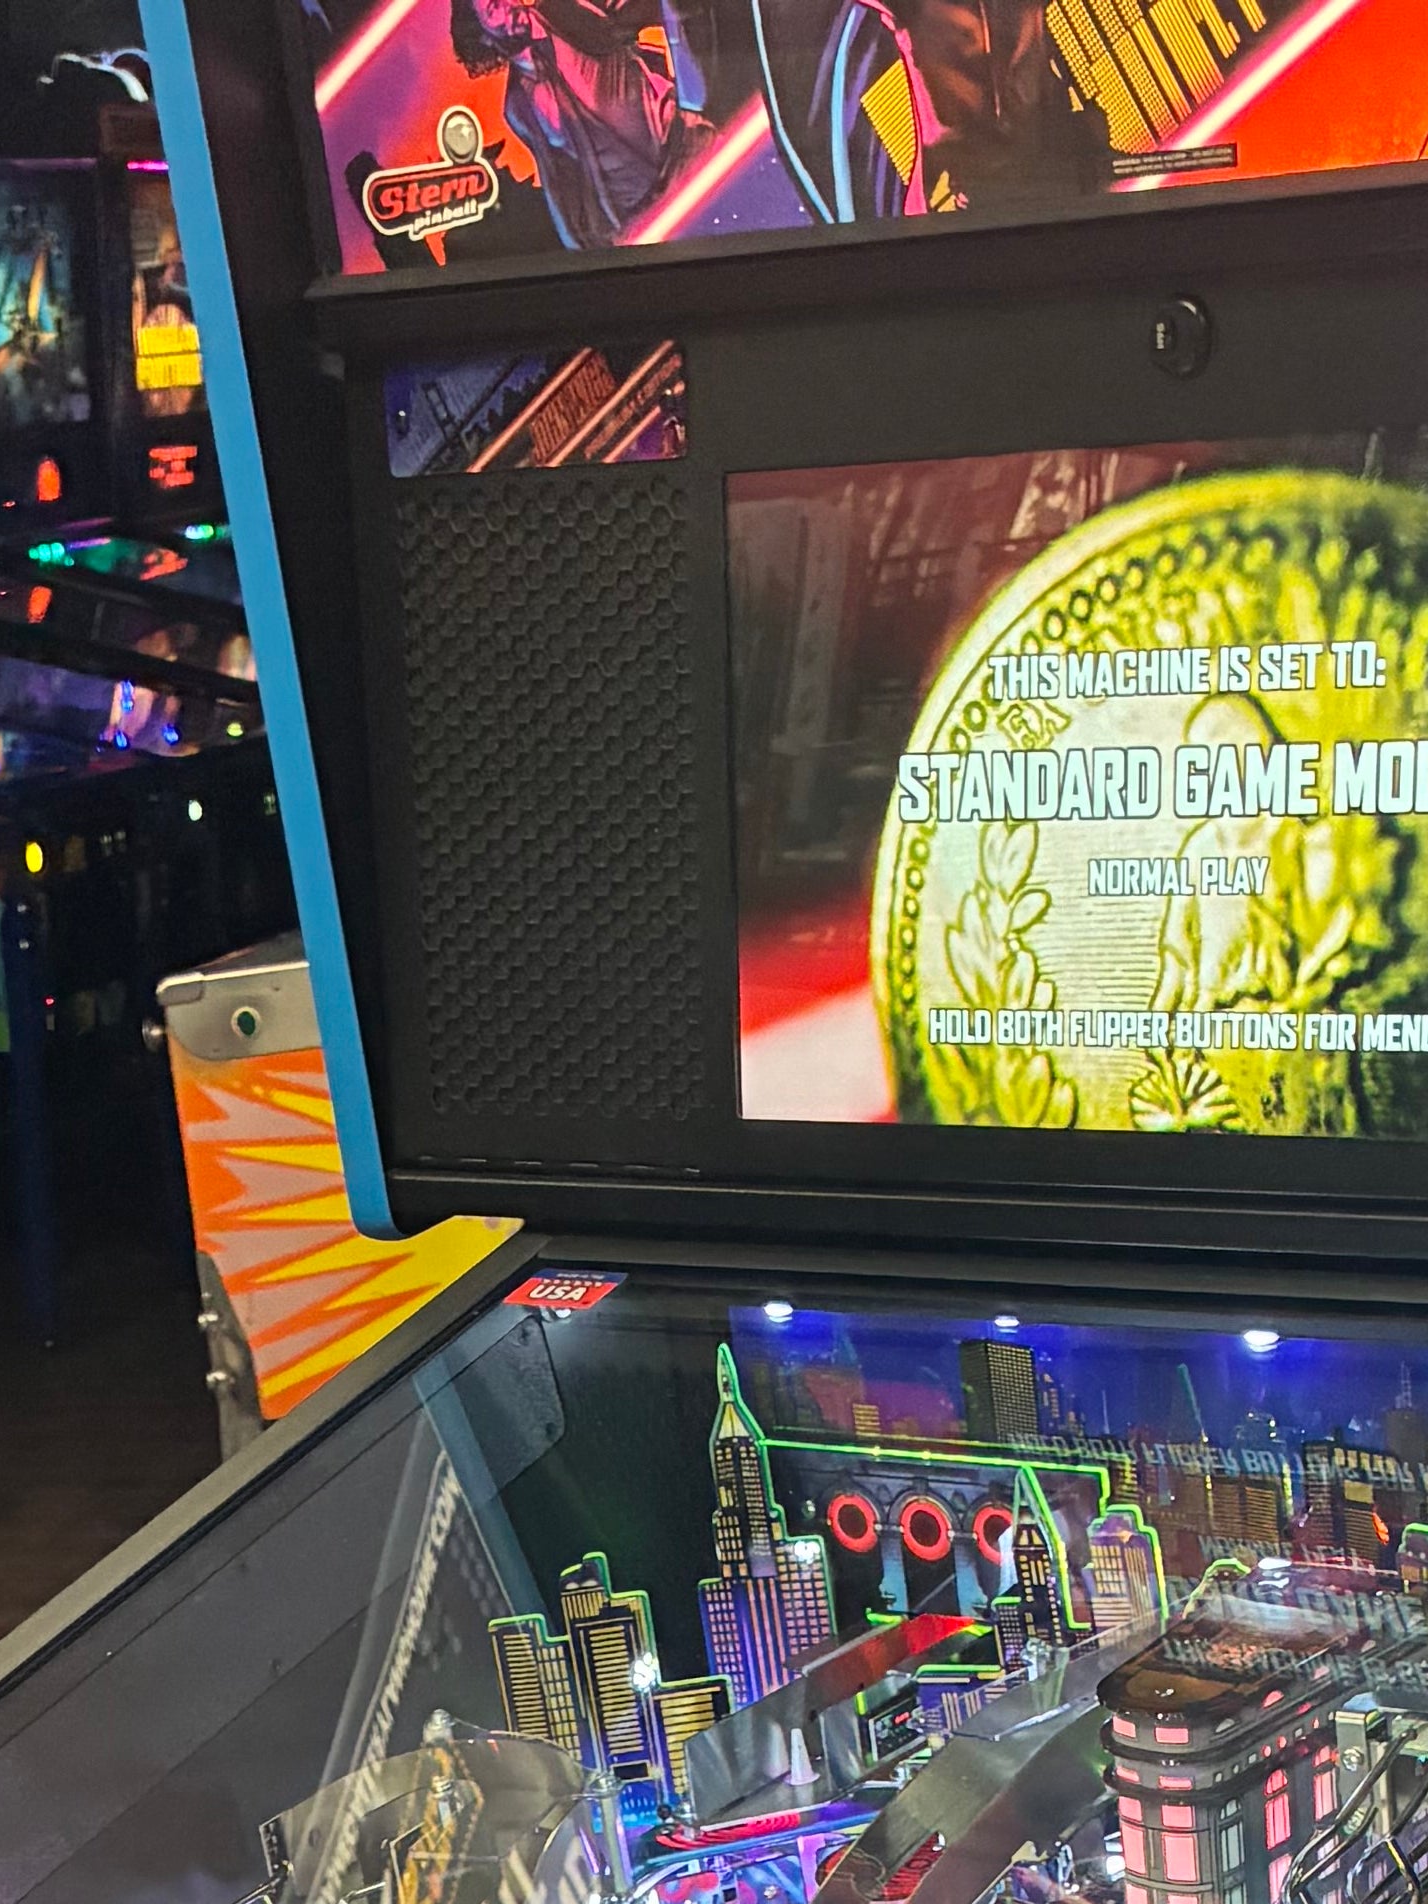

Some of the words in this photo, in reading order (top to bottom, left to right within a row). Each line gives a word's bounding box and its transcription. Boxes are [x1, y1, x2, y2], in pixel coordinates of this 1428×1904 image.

[380, 174, 480, 220] Stern
[414, 198, 477, 232] pinball
[989, 655, 1061, 699] THIS
[1066, 649, 1211, 698] MACHINE
[1218, 650, 1251, 693] IS
[1258, 644, 1323, 692] SET
[1330, 640, 1387, 690] TO:
[898, 745, 1161, 822] STANDARD
[1173, 741, 1320, 818] GAME
[1088, 857, 1195, 896] NORMAL
[1200, 856, 1270, 896] PLAY
[929, 1009, 991, 1045] HOLD
[997, 1010, 1064, 1046] BOTH
[1070, 1010, 1171, 1048] FLIPPER
[1173, 1012, 1298, 1050] BUTTONS
[1304, 1013, 1357, 1052] FOR
[529, 1285, 587, 1301] USA
